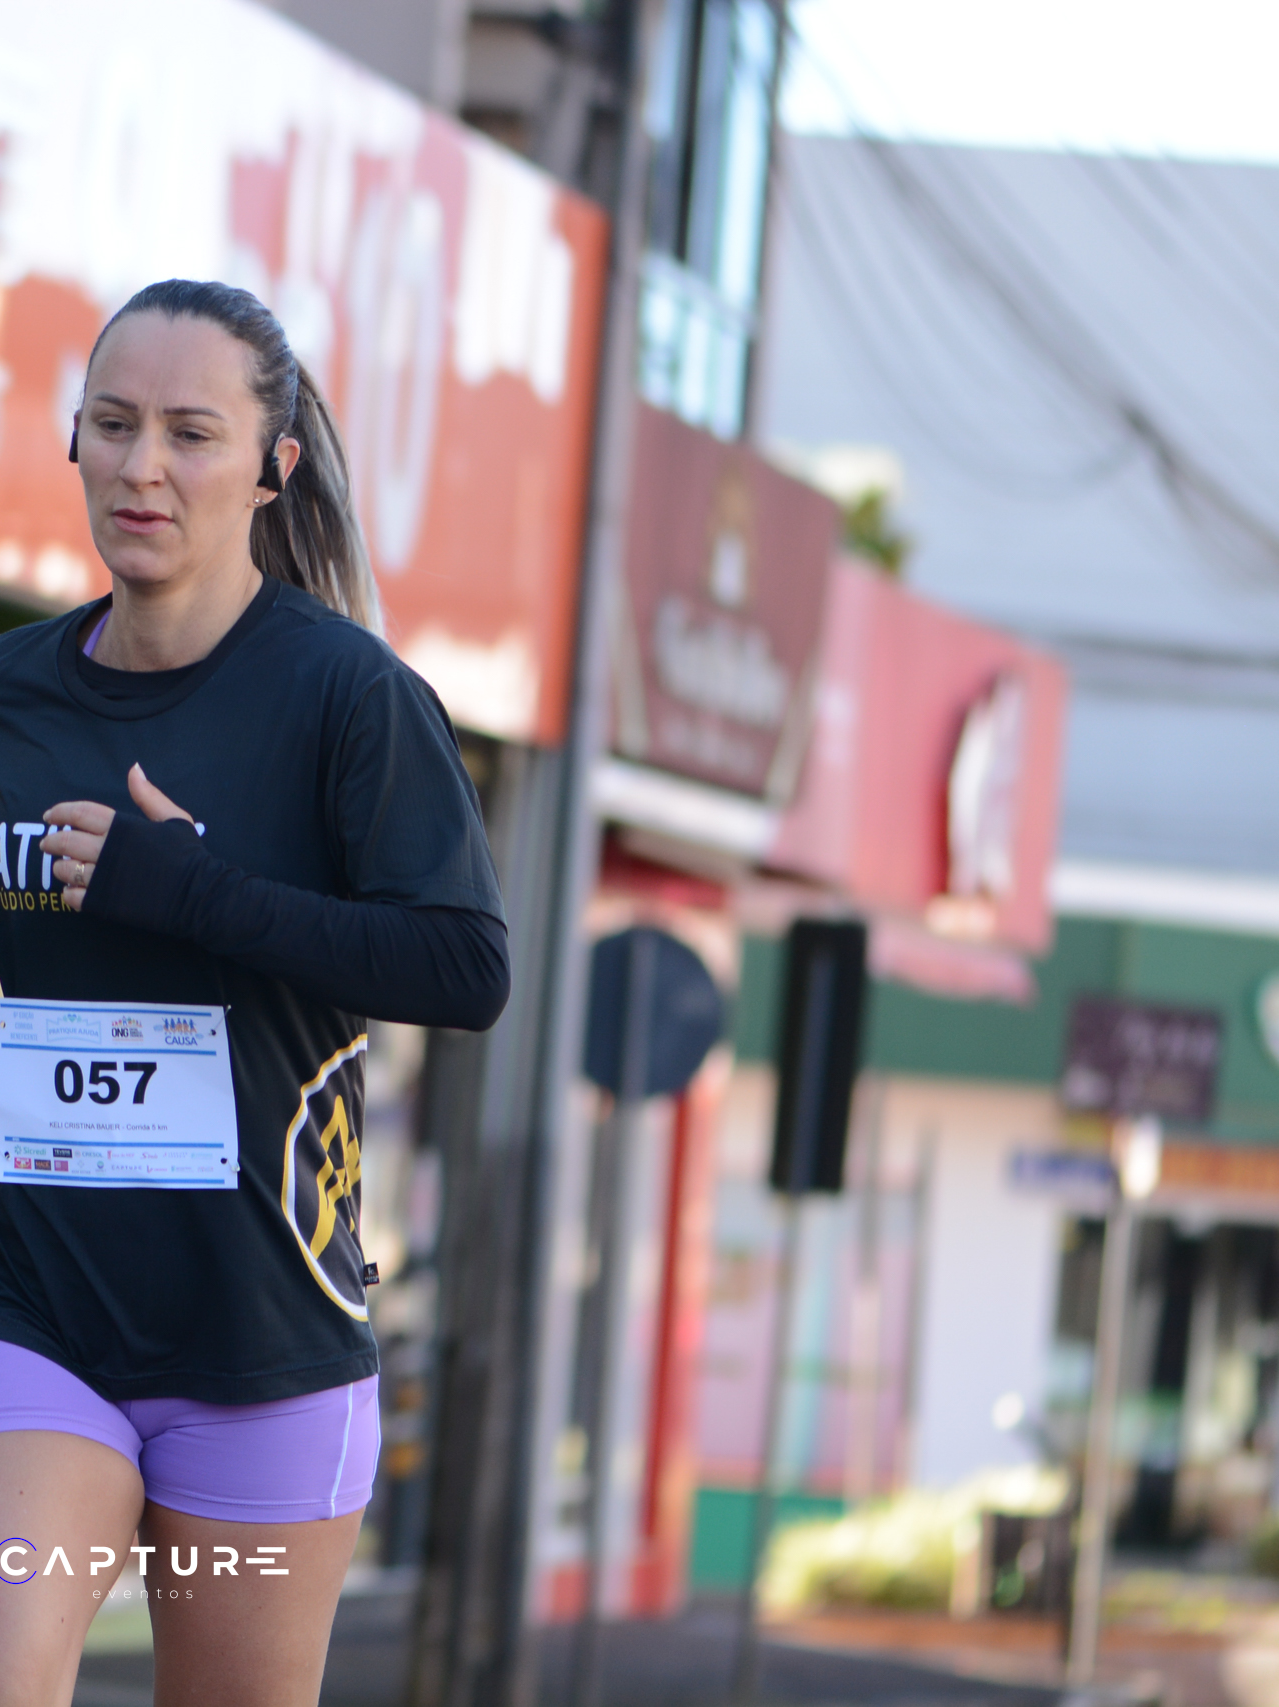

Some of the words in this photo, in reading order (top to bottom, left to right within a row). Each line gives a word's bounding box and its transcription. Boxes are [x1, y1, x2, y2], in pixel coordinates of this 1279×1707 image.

[48, 1027, 77, 1035] PRATIQUE
[78, 1028, 99, 1037] AJUDA
[111, 1027, 129, 1038] ONG
[164, 1035, 198, 1046] CAUSA
[54, 1059, 157, 1105] 057
[49, 1121, 63, 1129] KELI
[64, 1121, 96, 1130] CRISTINA
[96, 1122, 120, 1131] BAUER
[126, 1123, 151, 1131] Corrida
[23, 1146, 47, 1156] Sicredi
